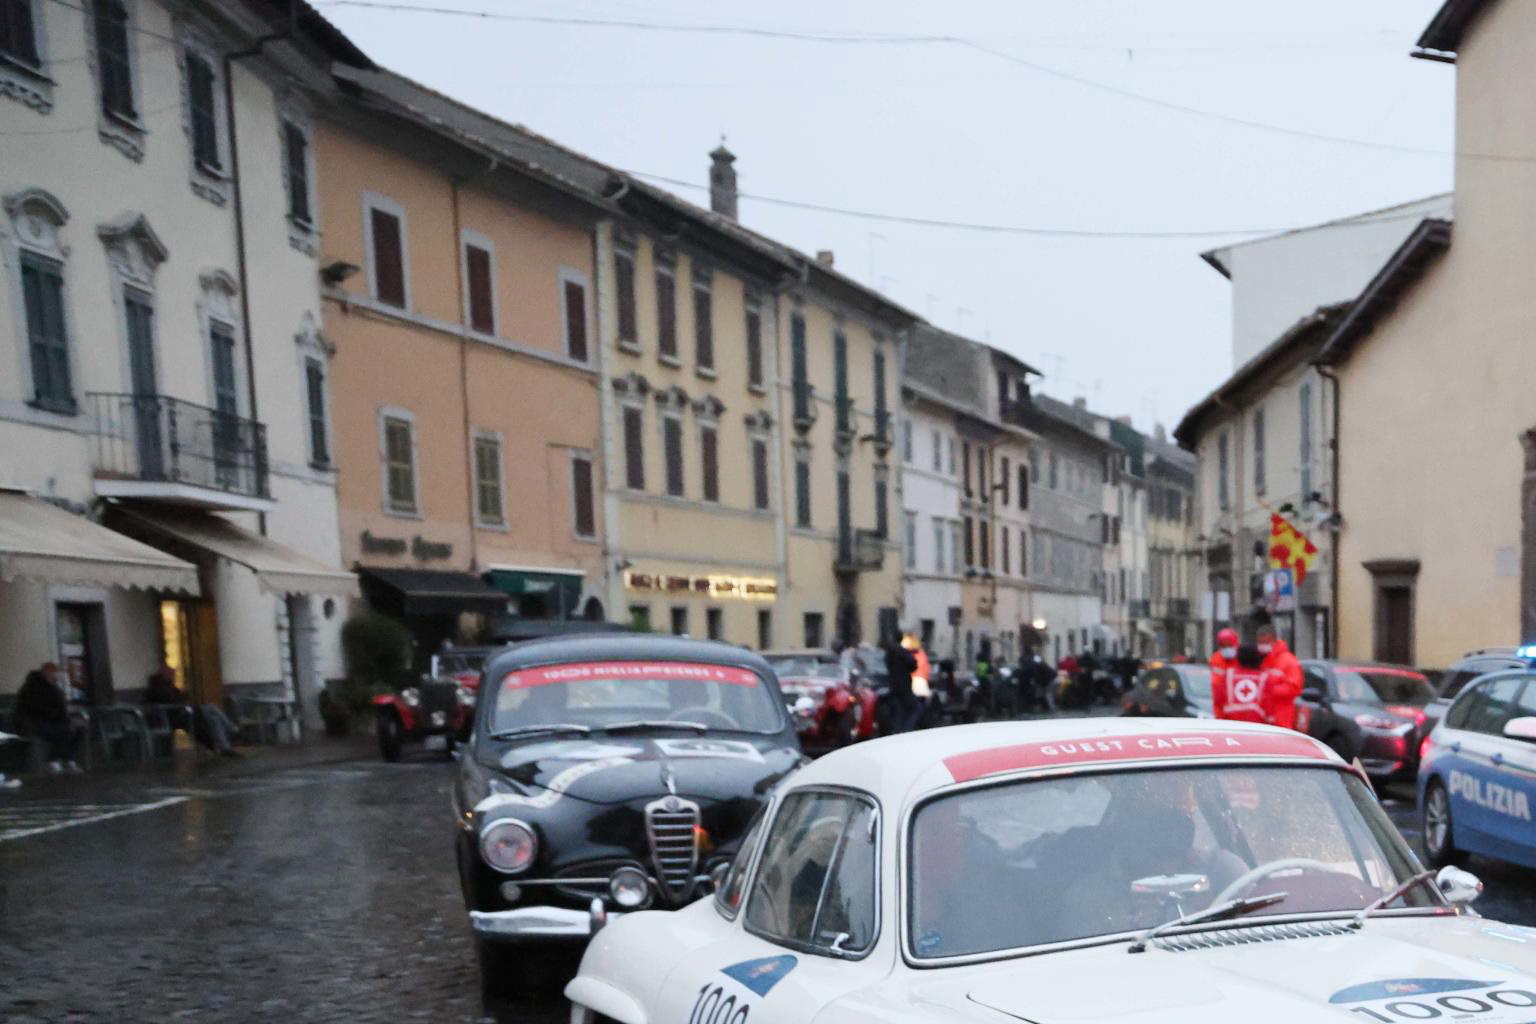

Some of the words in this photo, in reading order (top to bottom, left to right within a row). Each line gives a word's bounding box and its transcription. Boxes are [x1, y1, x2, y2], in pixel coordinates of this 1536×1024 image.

[1040, 739, 1124, 756] GUEST
[1137, 736, 1214, 749] CAR
[1225, 737, 1241, 748] A
[1449, 768, 1532, 822] POLIZIA
